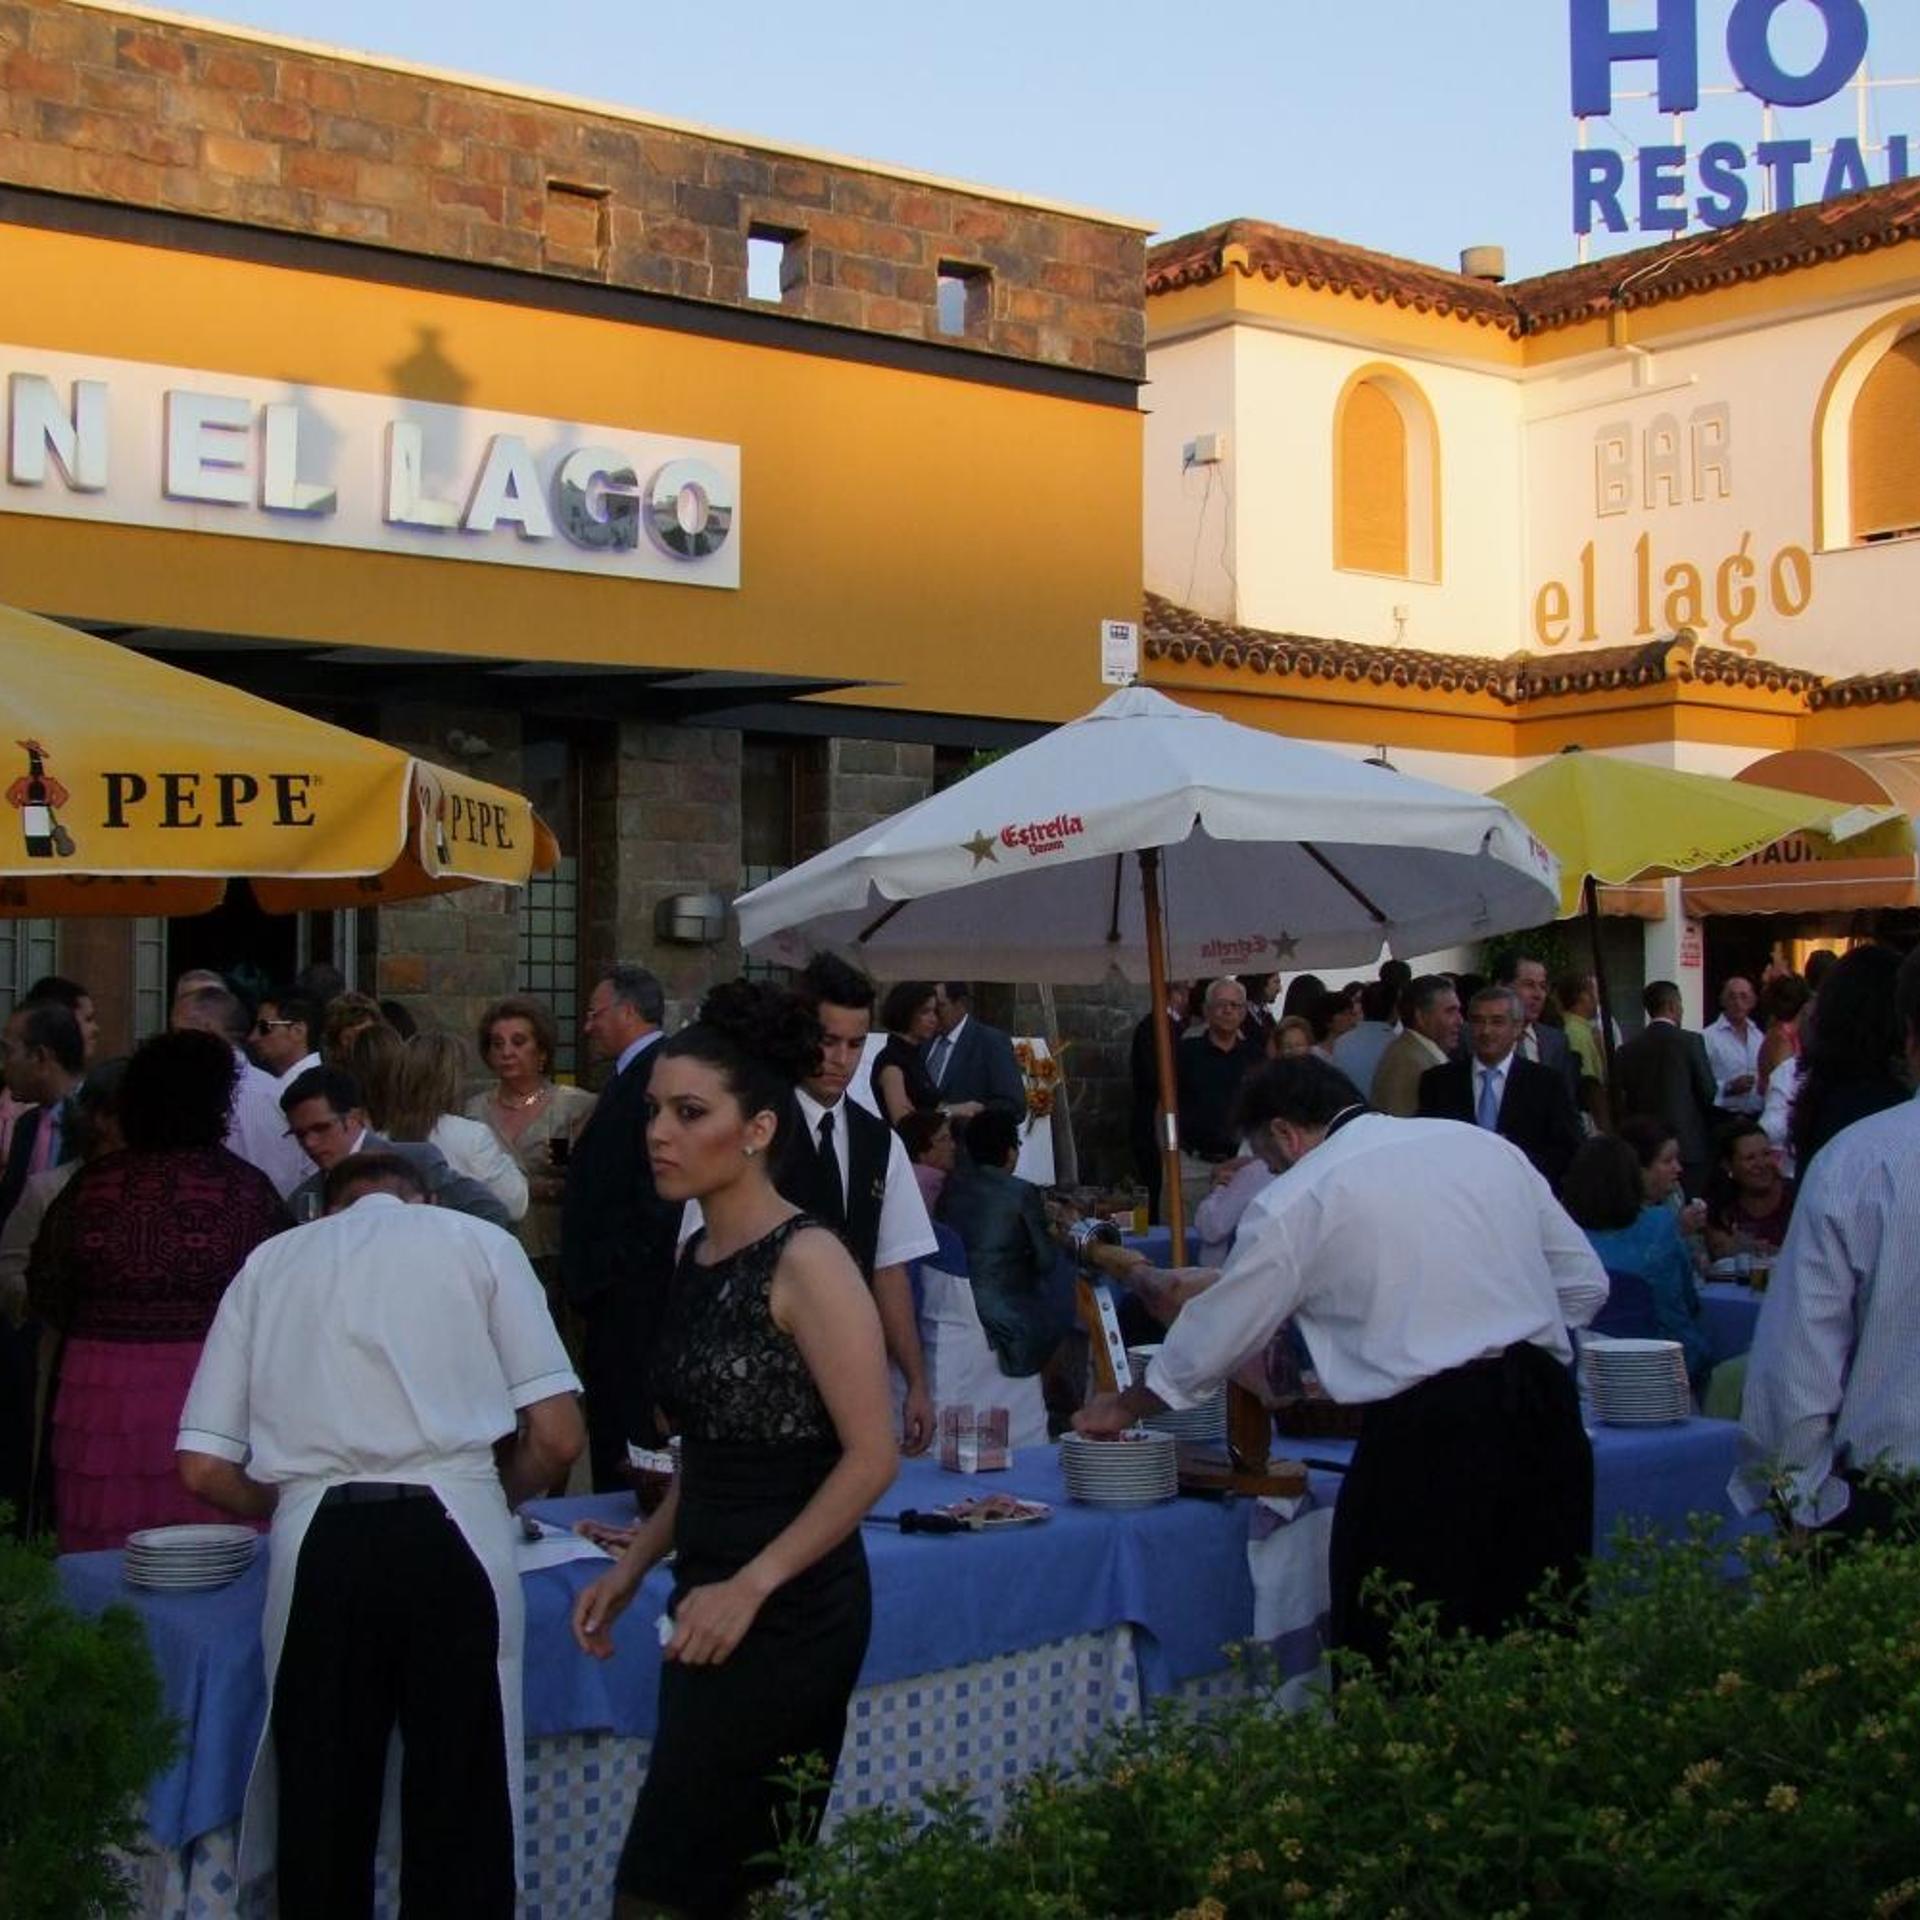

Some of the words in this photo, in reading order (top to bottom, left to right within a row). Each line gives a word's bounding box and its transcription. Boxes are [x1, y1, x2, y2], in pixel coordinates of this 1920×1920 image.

[1570, 0, 1868, 117] HO
[8, 372, 107, 492] N
[163, 390, 336, 516] EL
[383, 420, 732, 561] LAGO
[1593, 401, 1731, 519] BAR
[1535, 540, 1598, 646] el
[1633, 530, 1812, 656] lago
[100, 773, 316, 828] PEPE
[451, 794, 513, 849] PEPE
[1001, 814, 1083, 848] Estrella
